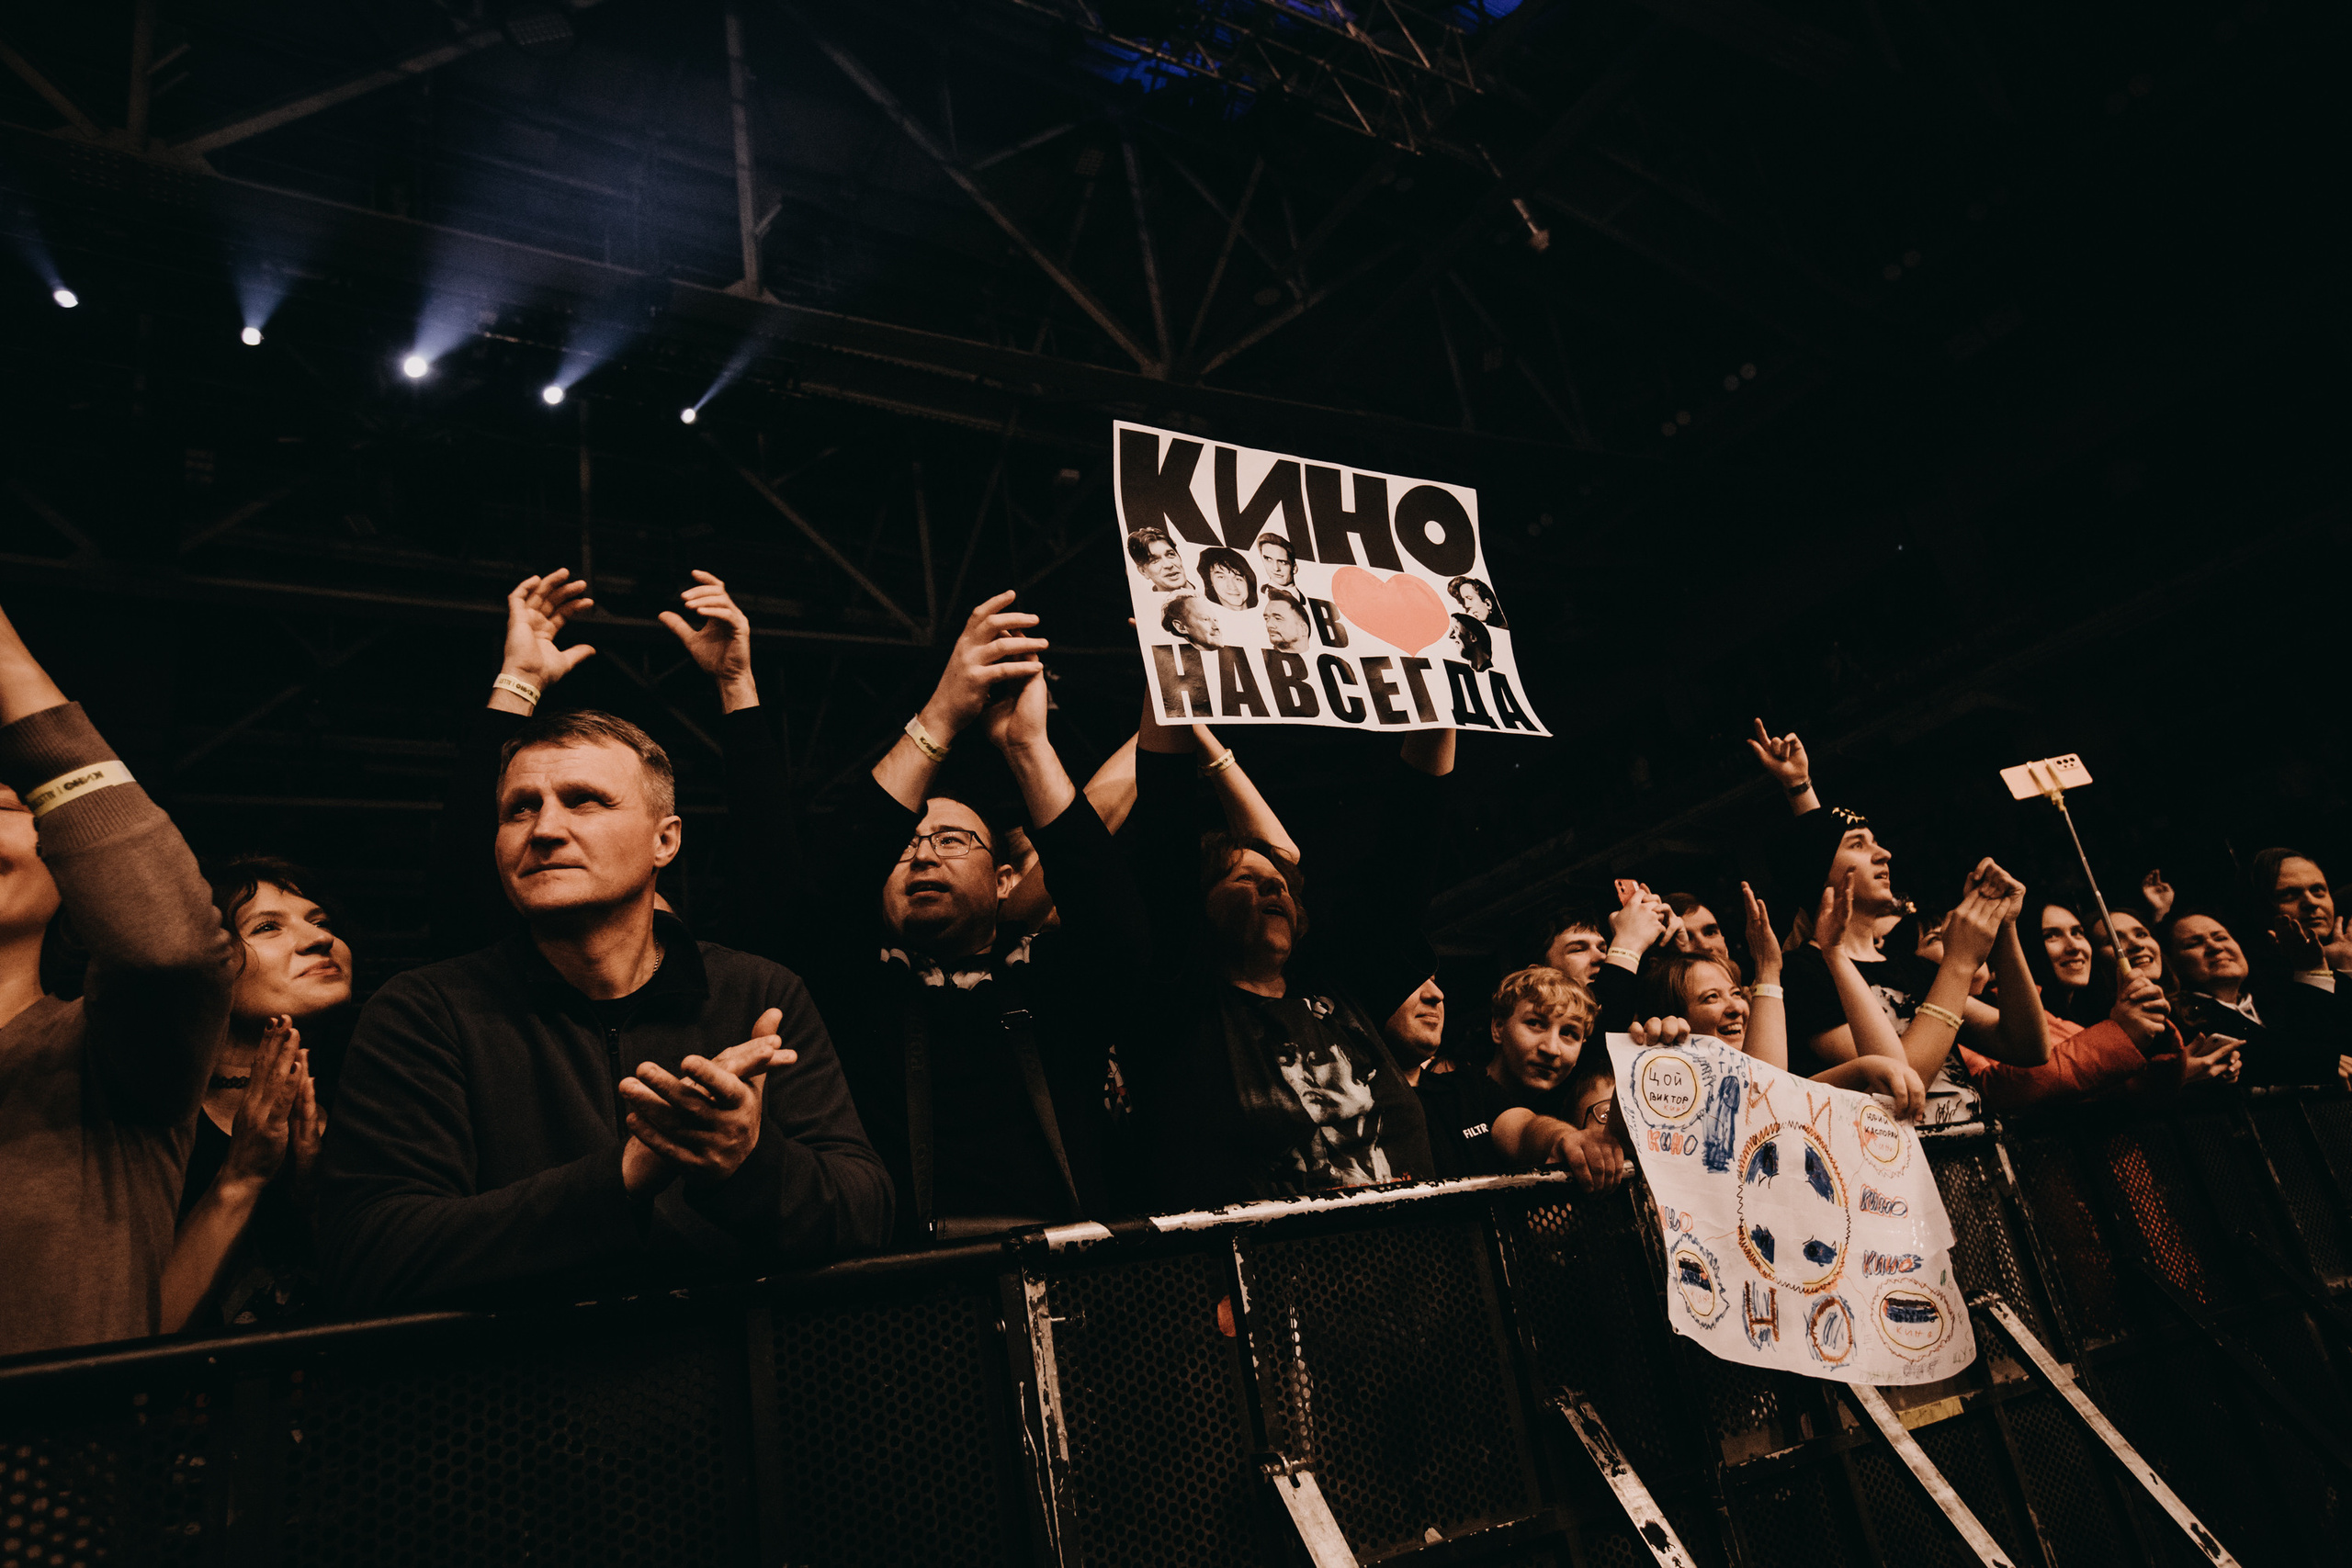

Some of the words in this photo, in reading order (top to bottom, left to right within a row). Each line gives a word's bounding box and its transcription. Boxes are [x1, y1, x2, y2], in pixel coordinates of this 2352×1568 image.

[1120, 428, 1476, 577] КИНО
[1151, 644, 1541, 732] НАВСЕГДА
[1649, 1067, 1682, 1087] ЦОЙ
[1649, 1092, 1689, 1105] ВИКТОР
[1463, 1122, 1488, 1139] FILTR
[1647, 1130, 1698, 1156] КИНО
[1862, 1250, 1914, 1278] КИНО
